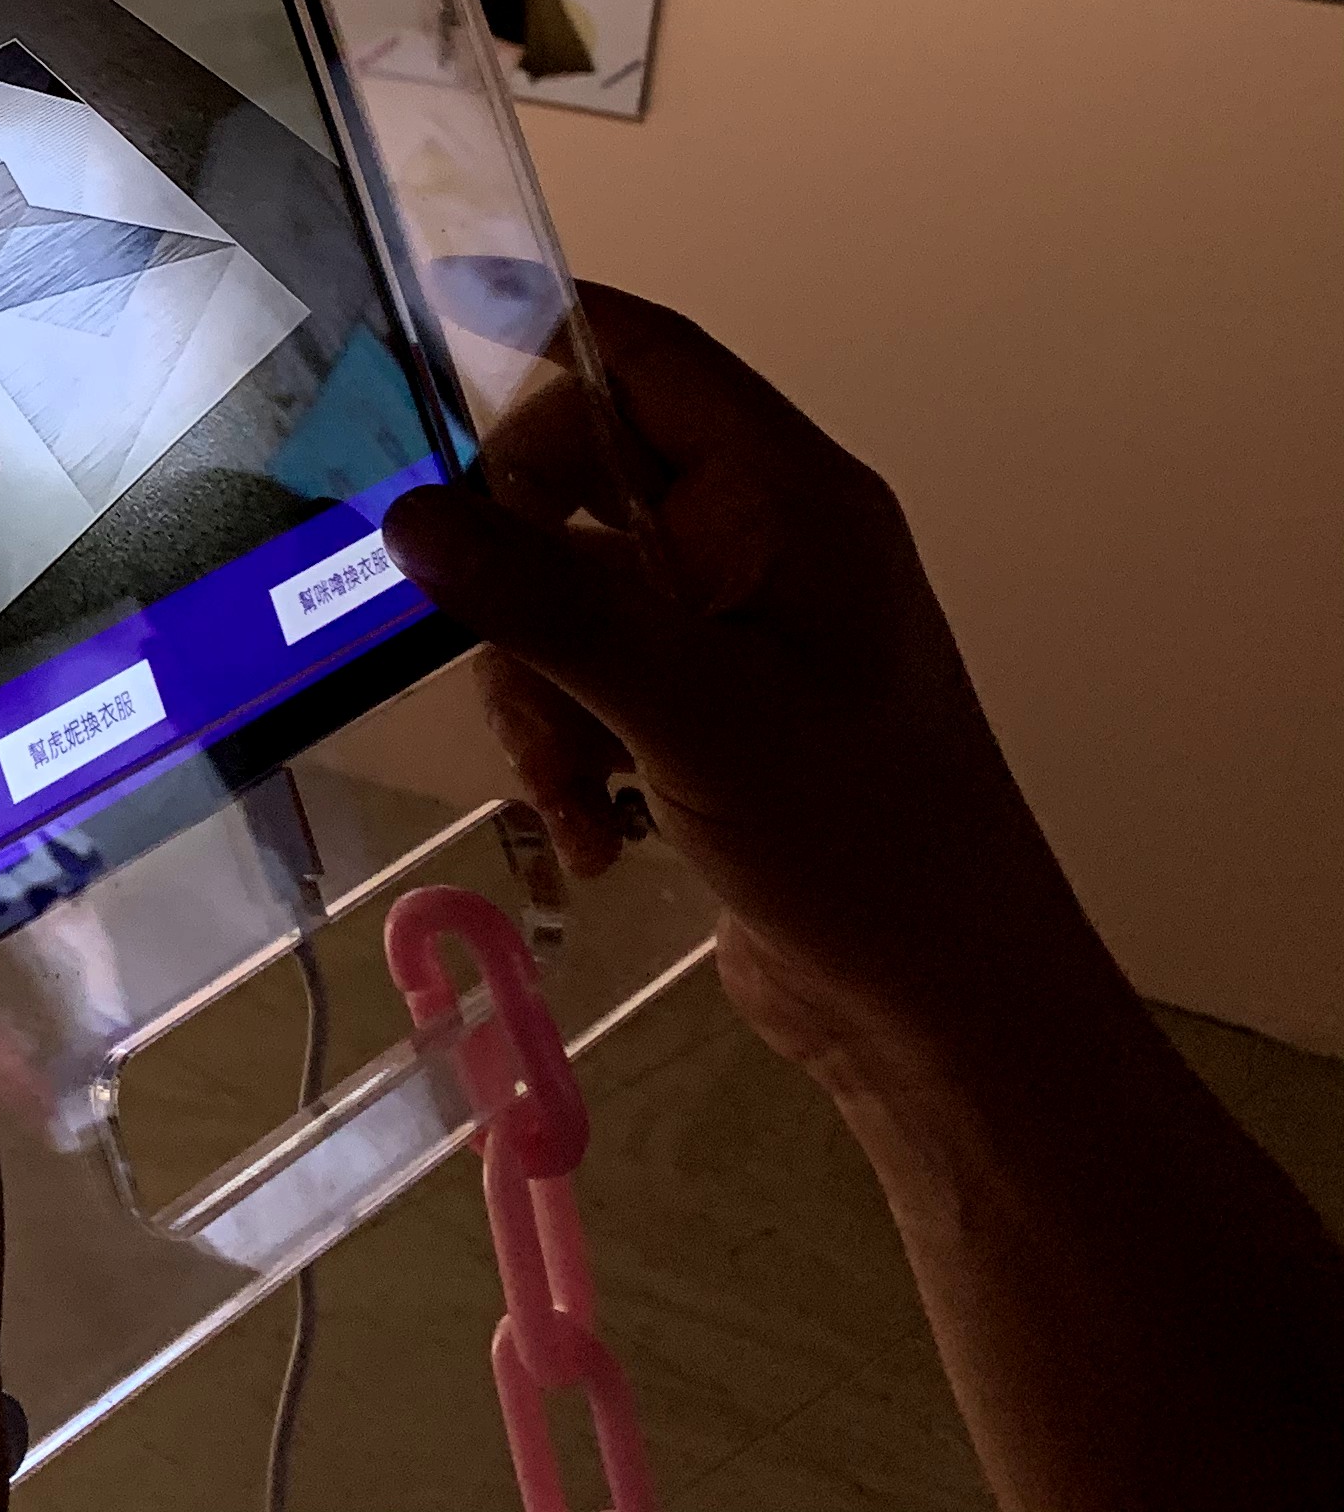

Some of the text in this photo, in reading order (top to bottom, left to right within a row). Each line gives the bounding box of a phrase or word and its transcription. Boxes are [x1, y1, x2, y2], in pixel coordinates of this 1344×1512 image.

[27, 690, 137, 771] 幫虎妮換衣服
